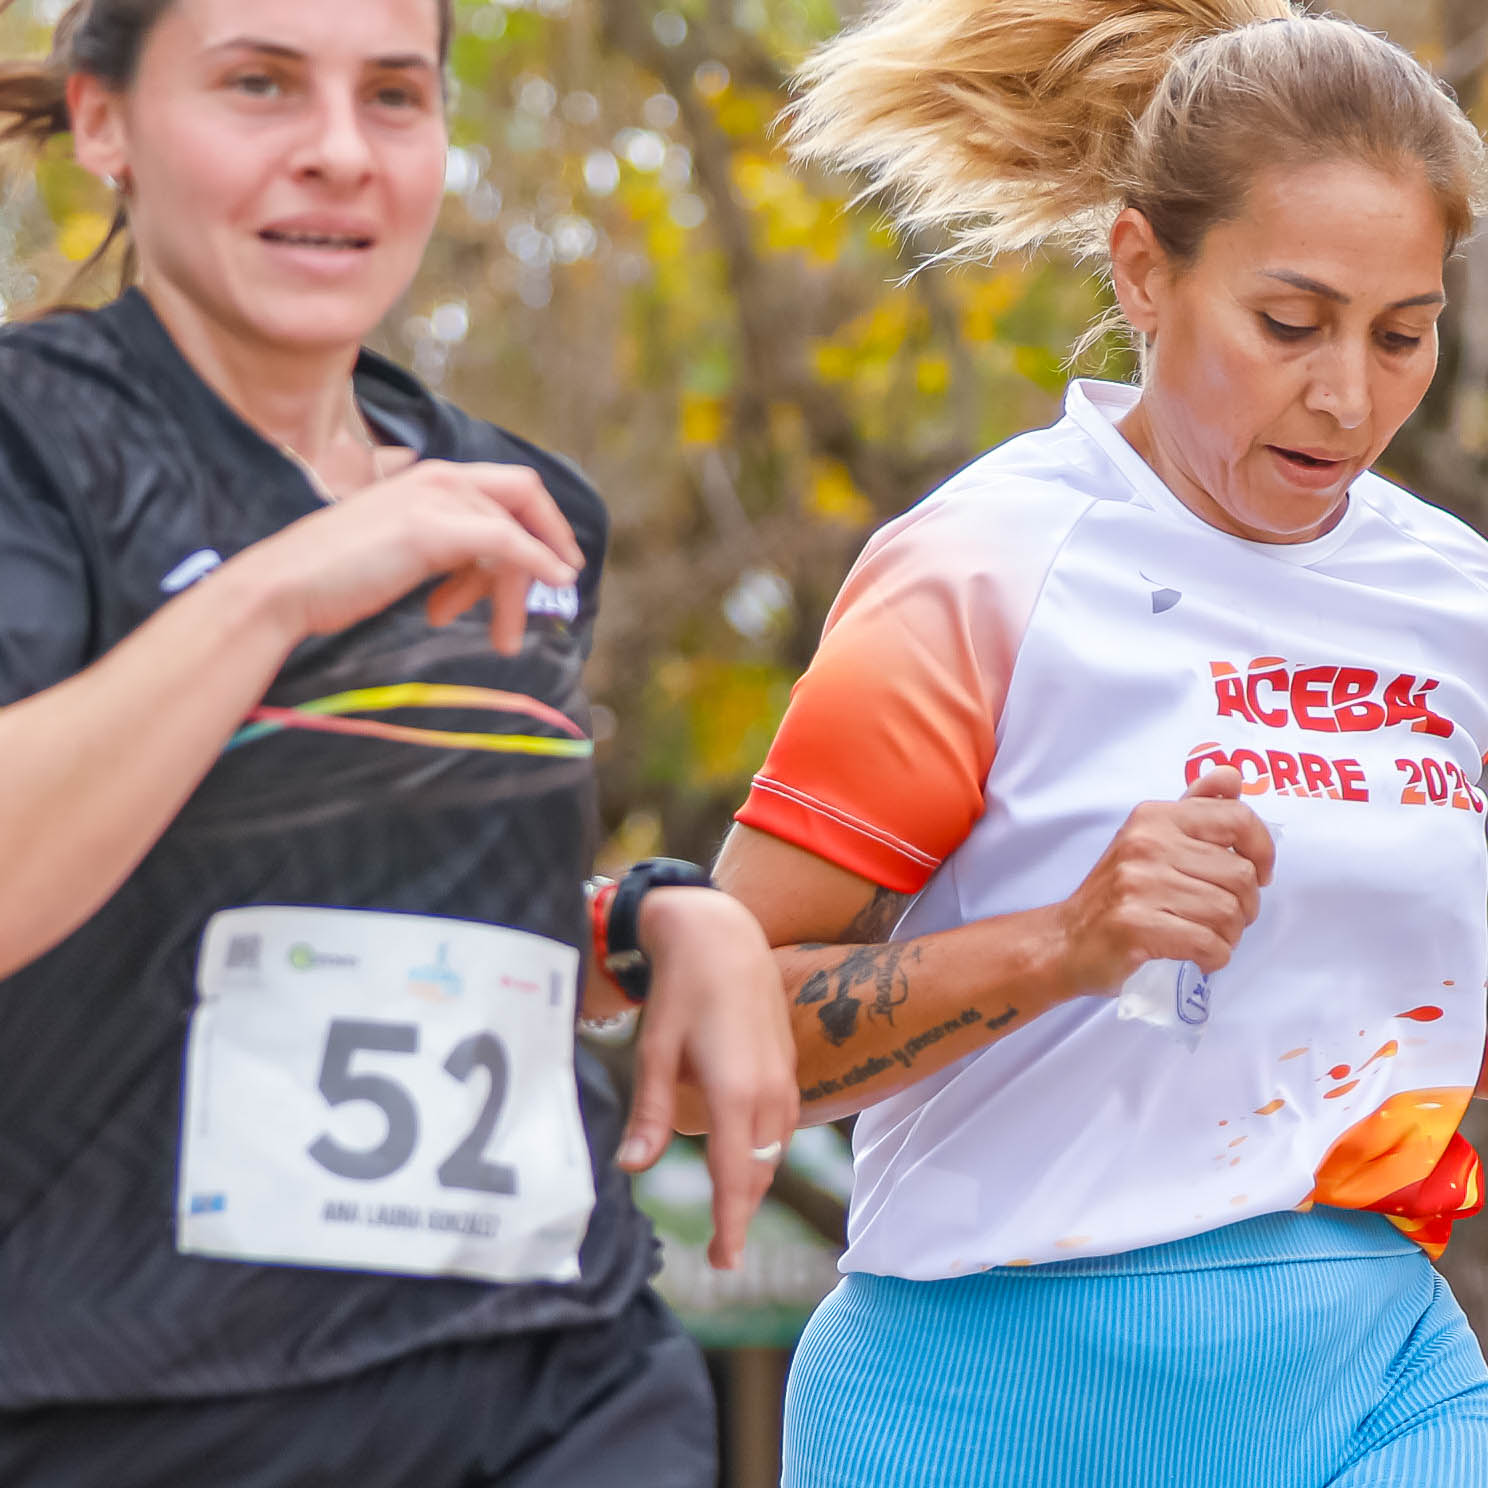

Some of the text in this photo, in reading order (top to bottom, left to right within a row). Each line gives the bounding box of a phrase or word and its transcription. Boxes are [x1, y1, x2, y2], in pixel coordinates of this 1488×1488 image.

[1209, 656, 1454, 738] ACEBAL
[1185, 741, 1369, 803] CORRE
[307, 1015, 518, 1196] 52
